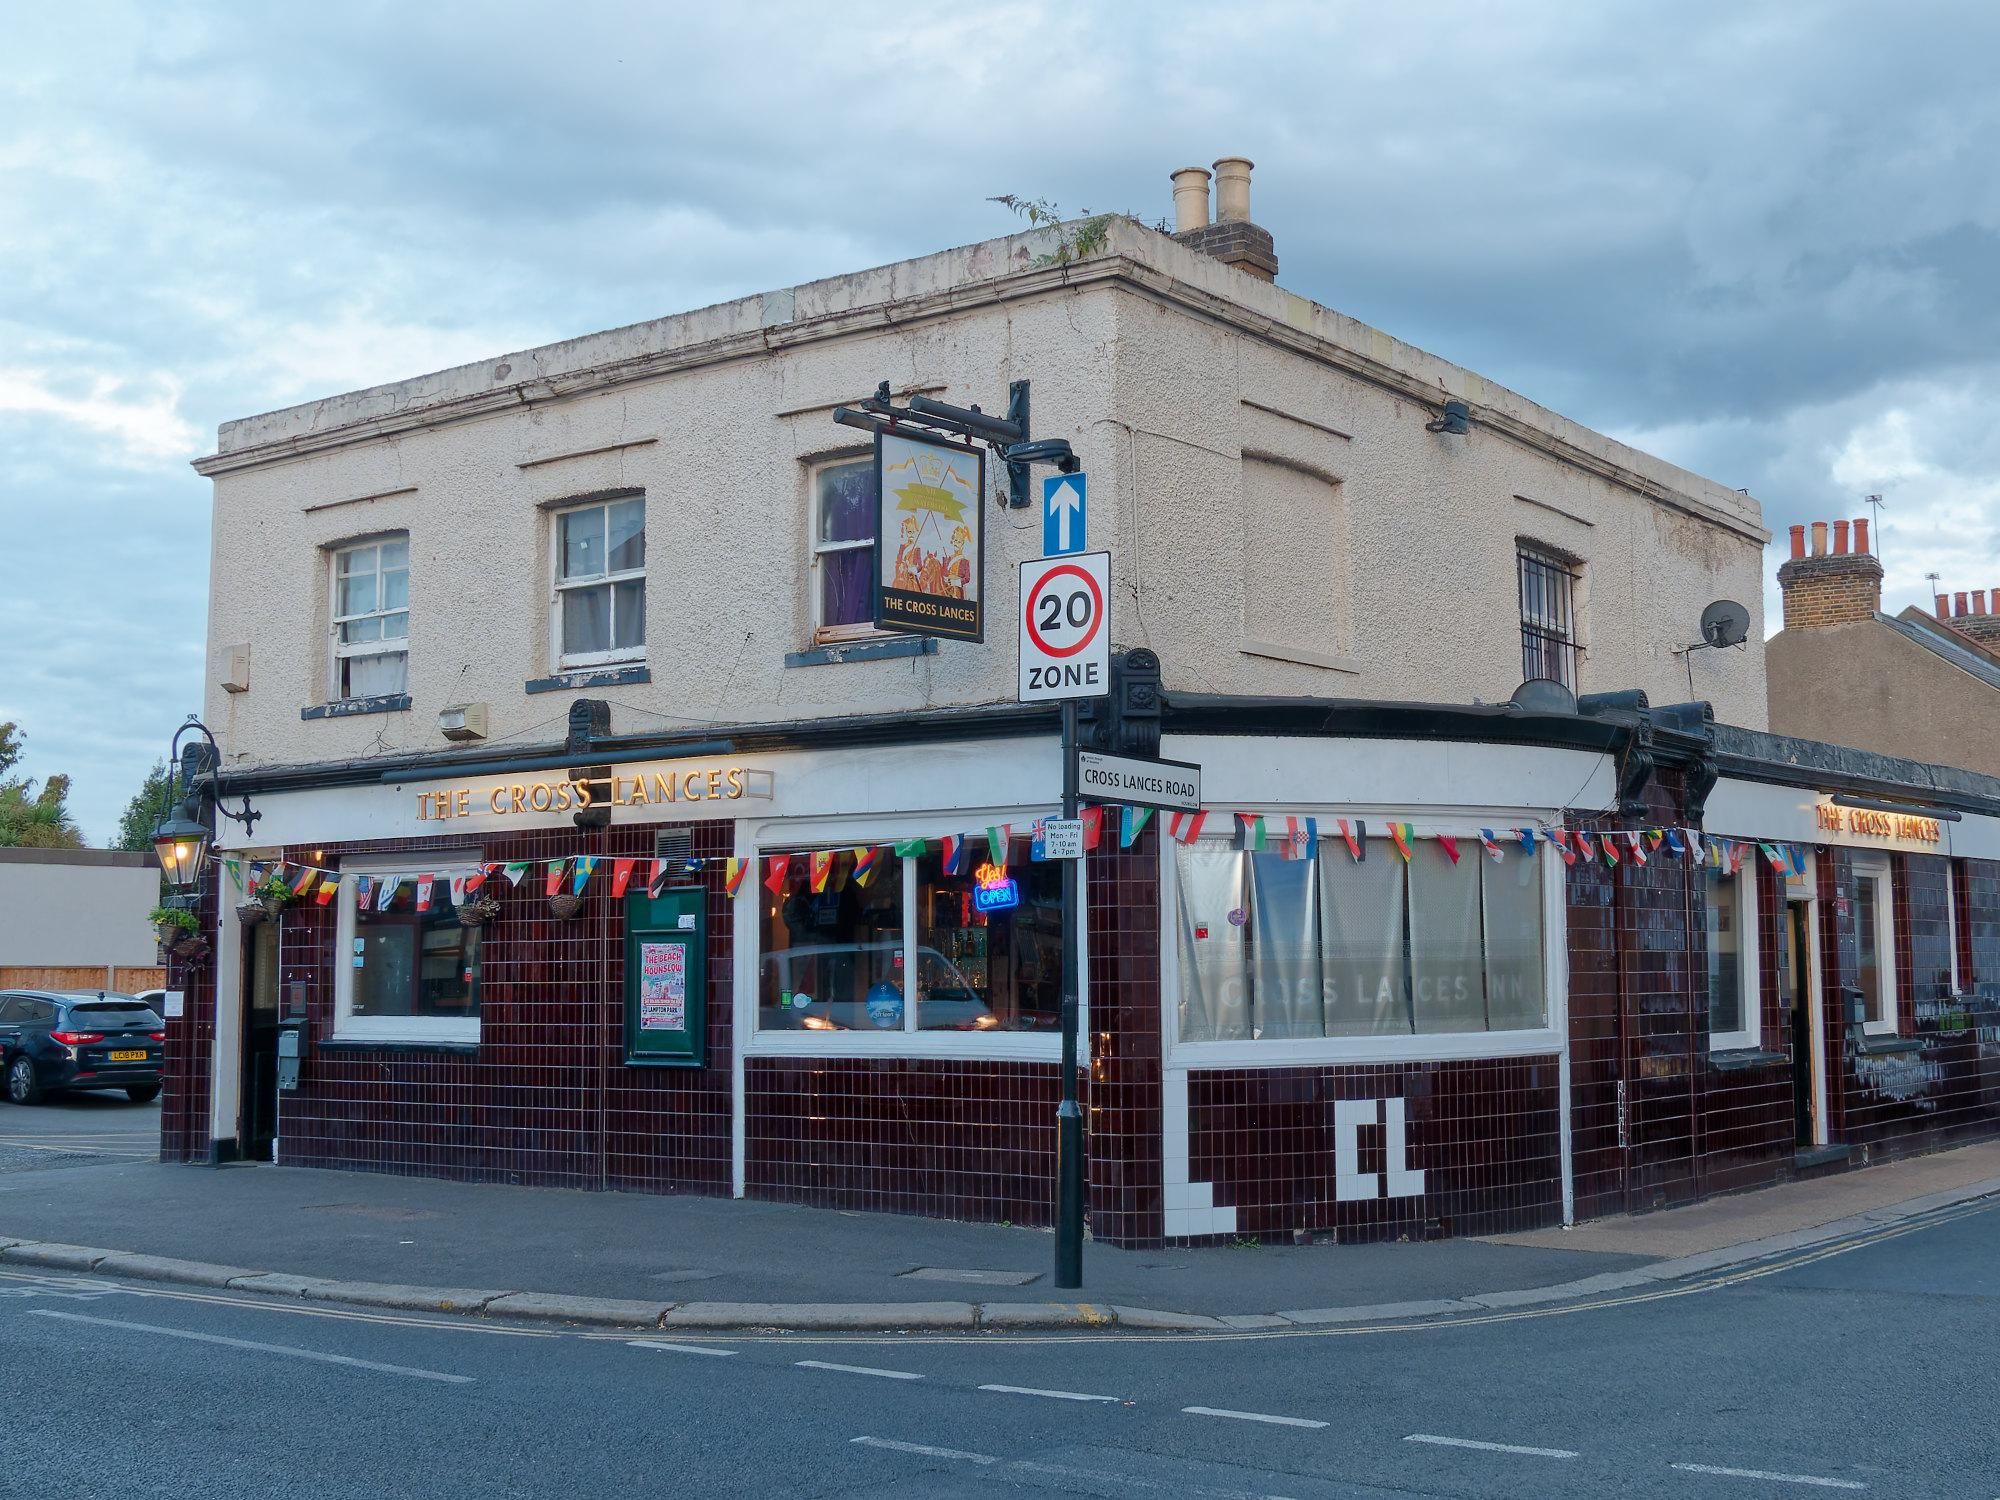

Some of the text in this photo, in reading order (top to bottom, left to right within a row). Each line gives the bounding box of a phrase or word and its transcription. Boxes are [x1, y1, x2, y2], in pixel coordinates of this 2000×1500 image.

[884, 596, 975, 622] THE CROSS LANCES
[1039, 590, 1092, 631] 20
[1029, 662, 1099, 690] ZONE
[417, 767, 744, 821] THE CROSS LANCES
[1084, 768, 1195, 797] CROSS LANCES ROAD
[1816, 804, 1940, 842] THE CROSS LANCES
[975, 863, 1006, 889] Yes!
[980, 887, 1012, 905] OPEN
[644, 964, 682, 974] HOUNSLOW
[645, 952, 682, 964] THE BEACH
